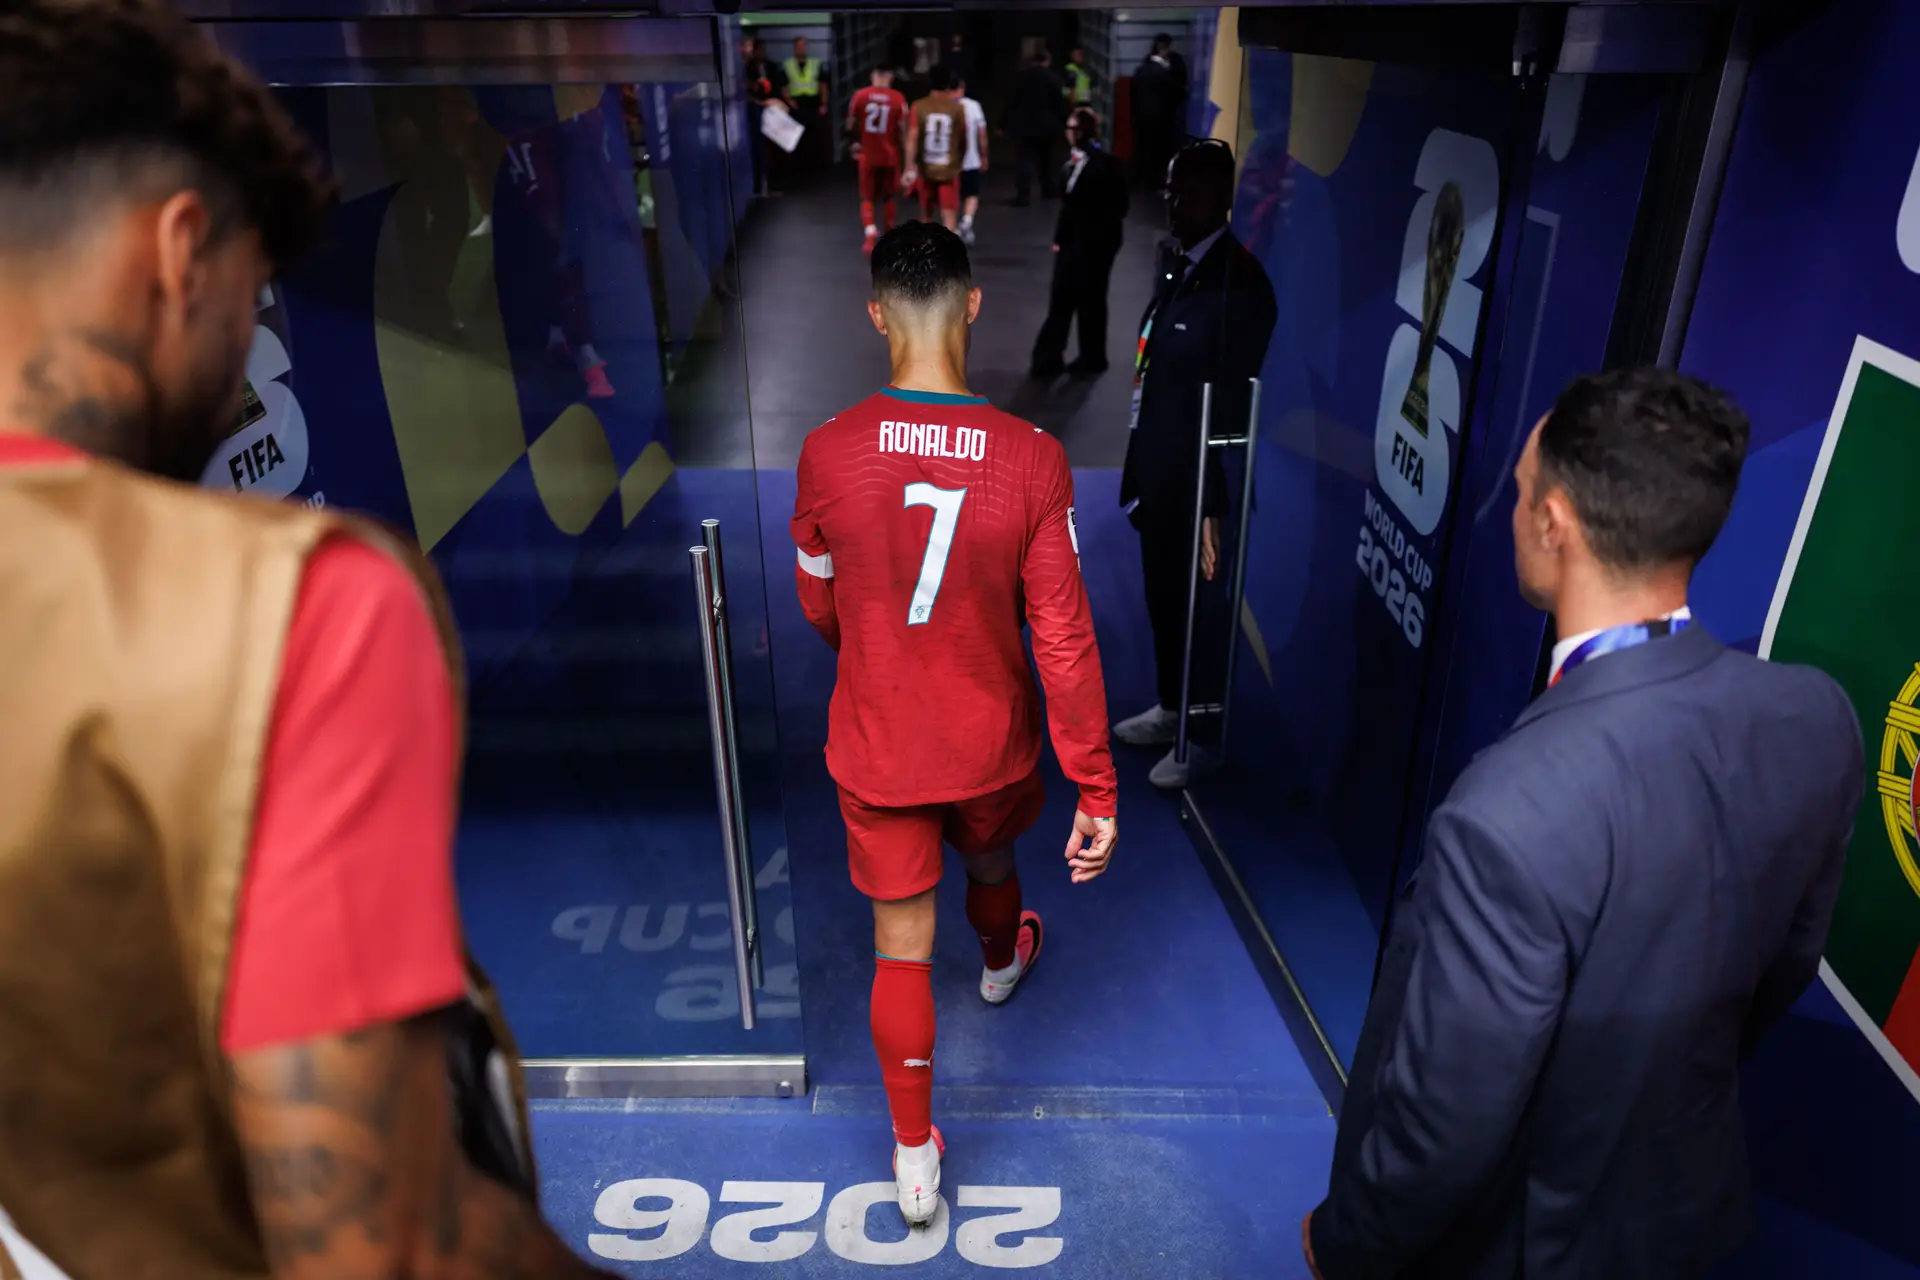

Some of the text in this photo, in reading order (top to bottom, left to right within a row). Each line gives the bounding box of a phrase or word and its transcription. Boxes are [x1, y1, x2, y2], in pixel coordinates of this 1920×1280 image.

[864, 102, 891, 134] 21
[228, 433, 285, 494] FIFA
[878, 421, 987, 462] RONALDO
[1391, 430, 1425, 496] FIFA
[903, 481, 968, 627] 7
[1364, 487, 1432, 592] WORLD CUP
[1356, 525, 1425, 649] 2026
[588, 1177, 1064, 1268] 2026
